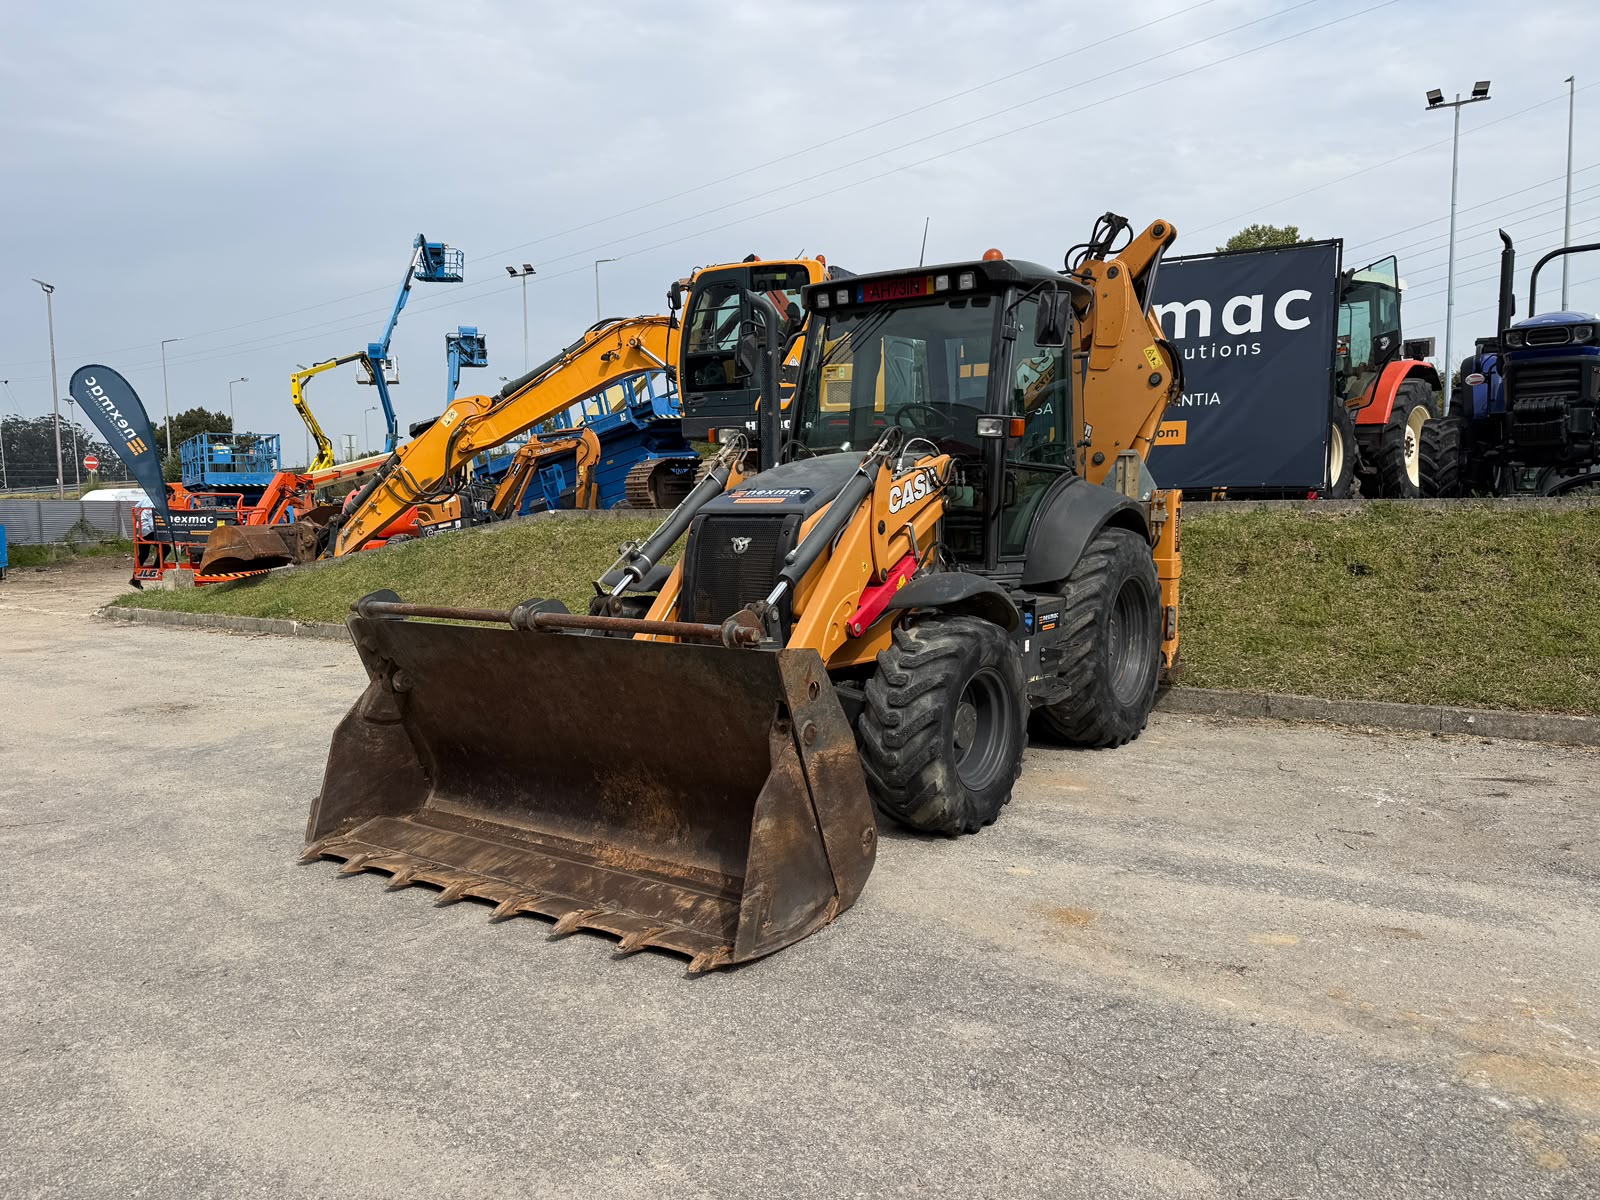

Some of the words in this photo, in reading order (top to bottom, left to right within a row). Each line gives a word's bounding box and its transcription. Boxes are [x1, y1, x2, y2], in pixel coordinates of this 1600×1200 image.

[1152, 289, 1312, 339] mac
[1184, 342, 1261, 360] utions
[1178, 392, 1221, 407] NTIA
[1156, 428, 1179, 438] om
[137, 569, 158, 578] JLG
